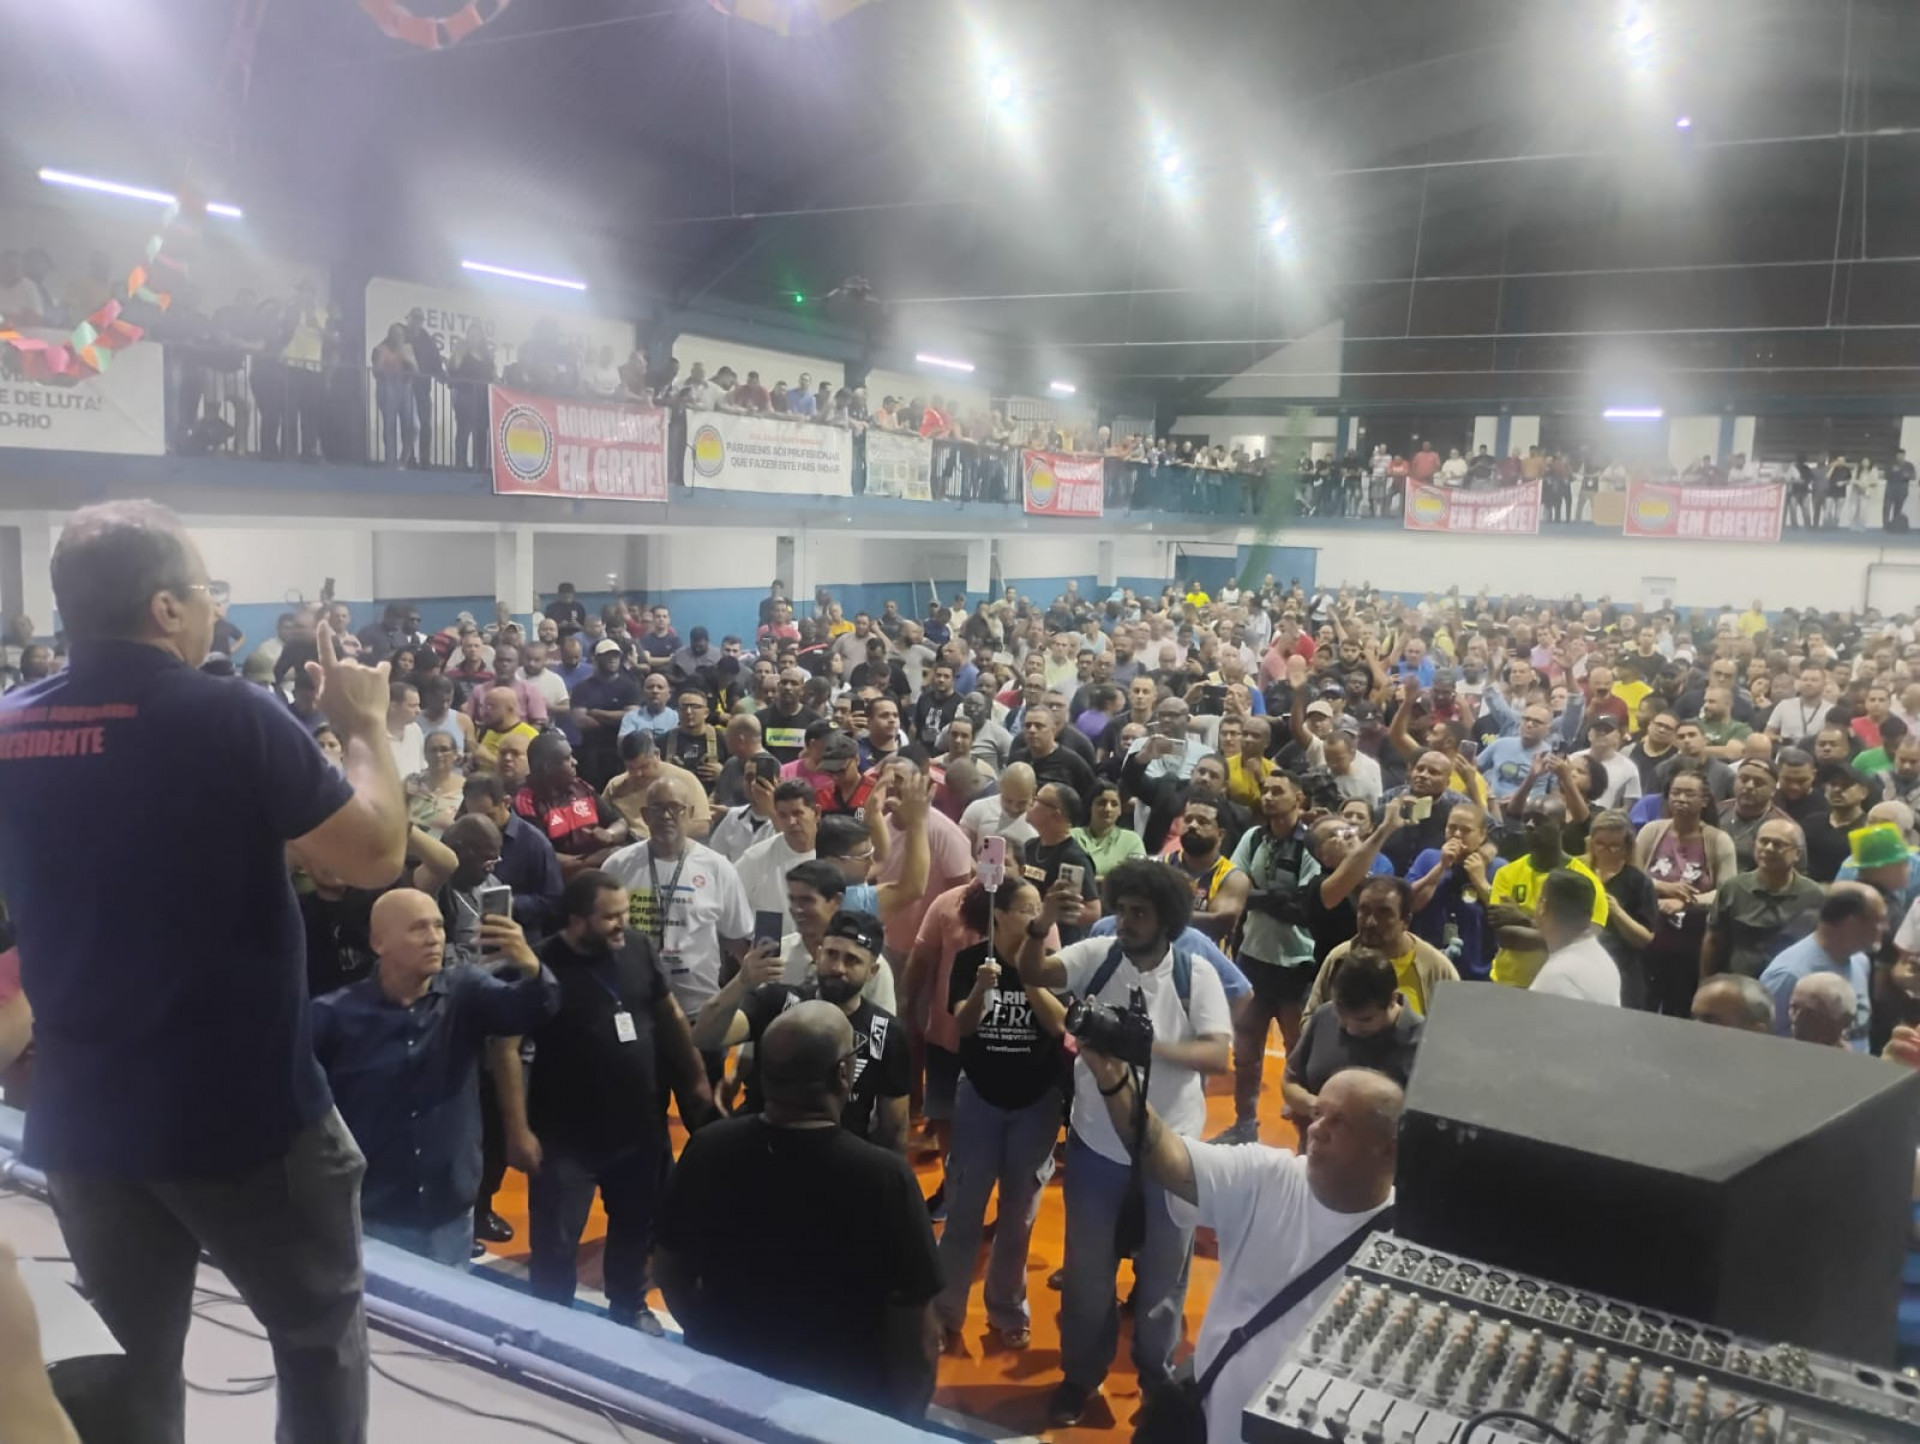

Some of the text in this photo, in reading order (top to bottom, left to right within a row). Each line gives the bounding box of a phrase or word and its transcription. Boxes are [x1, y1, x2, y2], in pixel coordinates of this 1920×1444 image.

[426, 309, 494, 336] ENTO
[14, 391, 41, 406] DE
[558, 444, 664, 497] EM GREVE!
[1677, 509, 1776, 538] EM GREVE!
[984, 1003, 1033, 1027] ER
